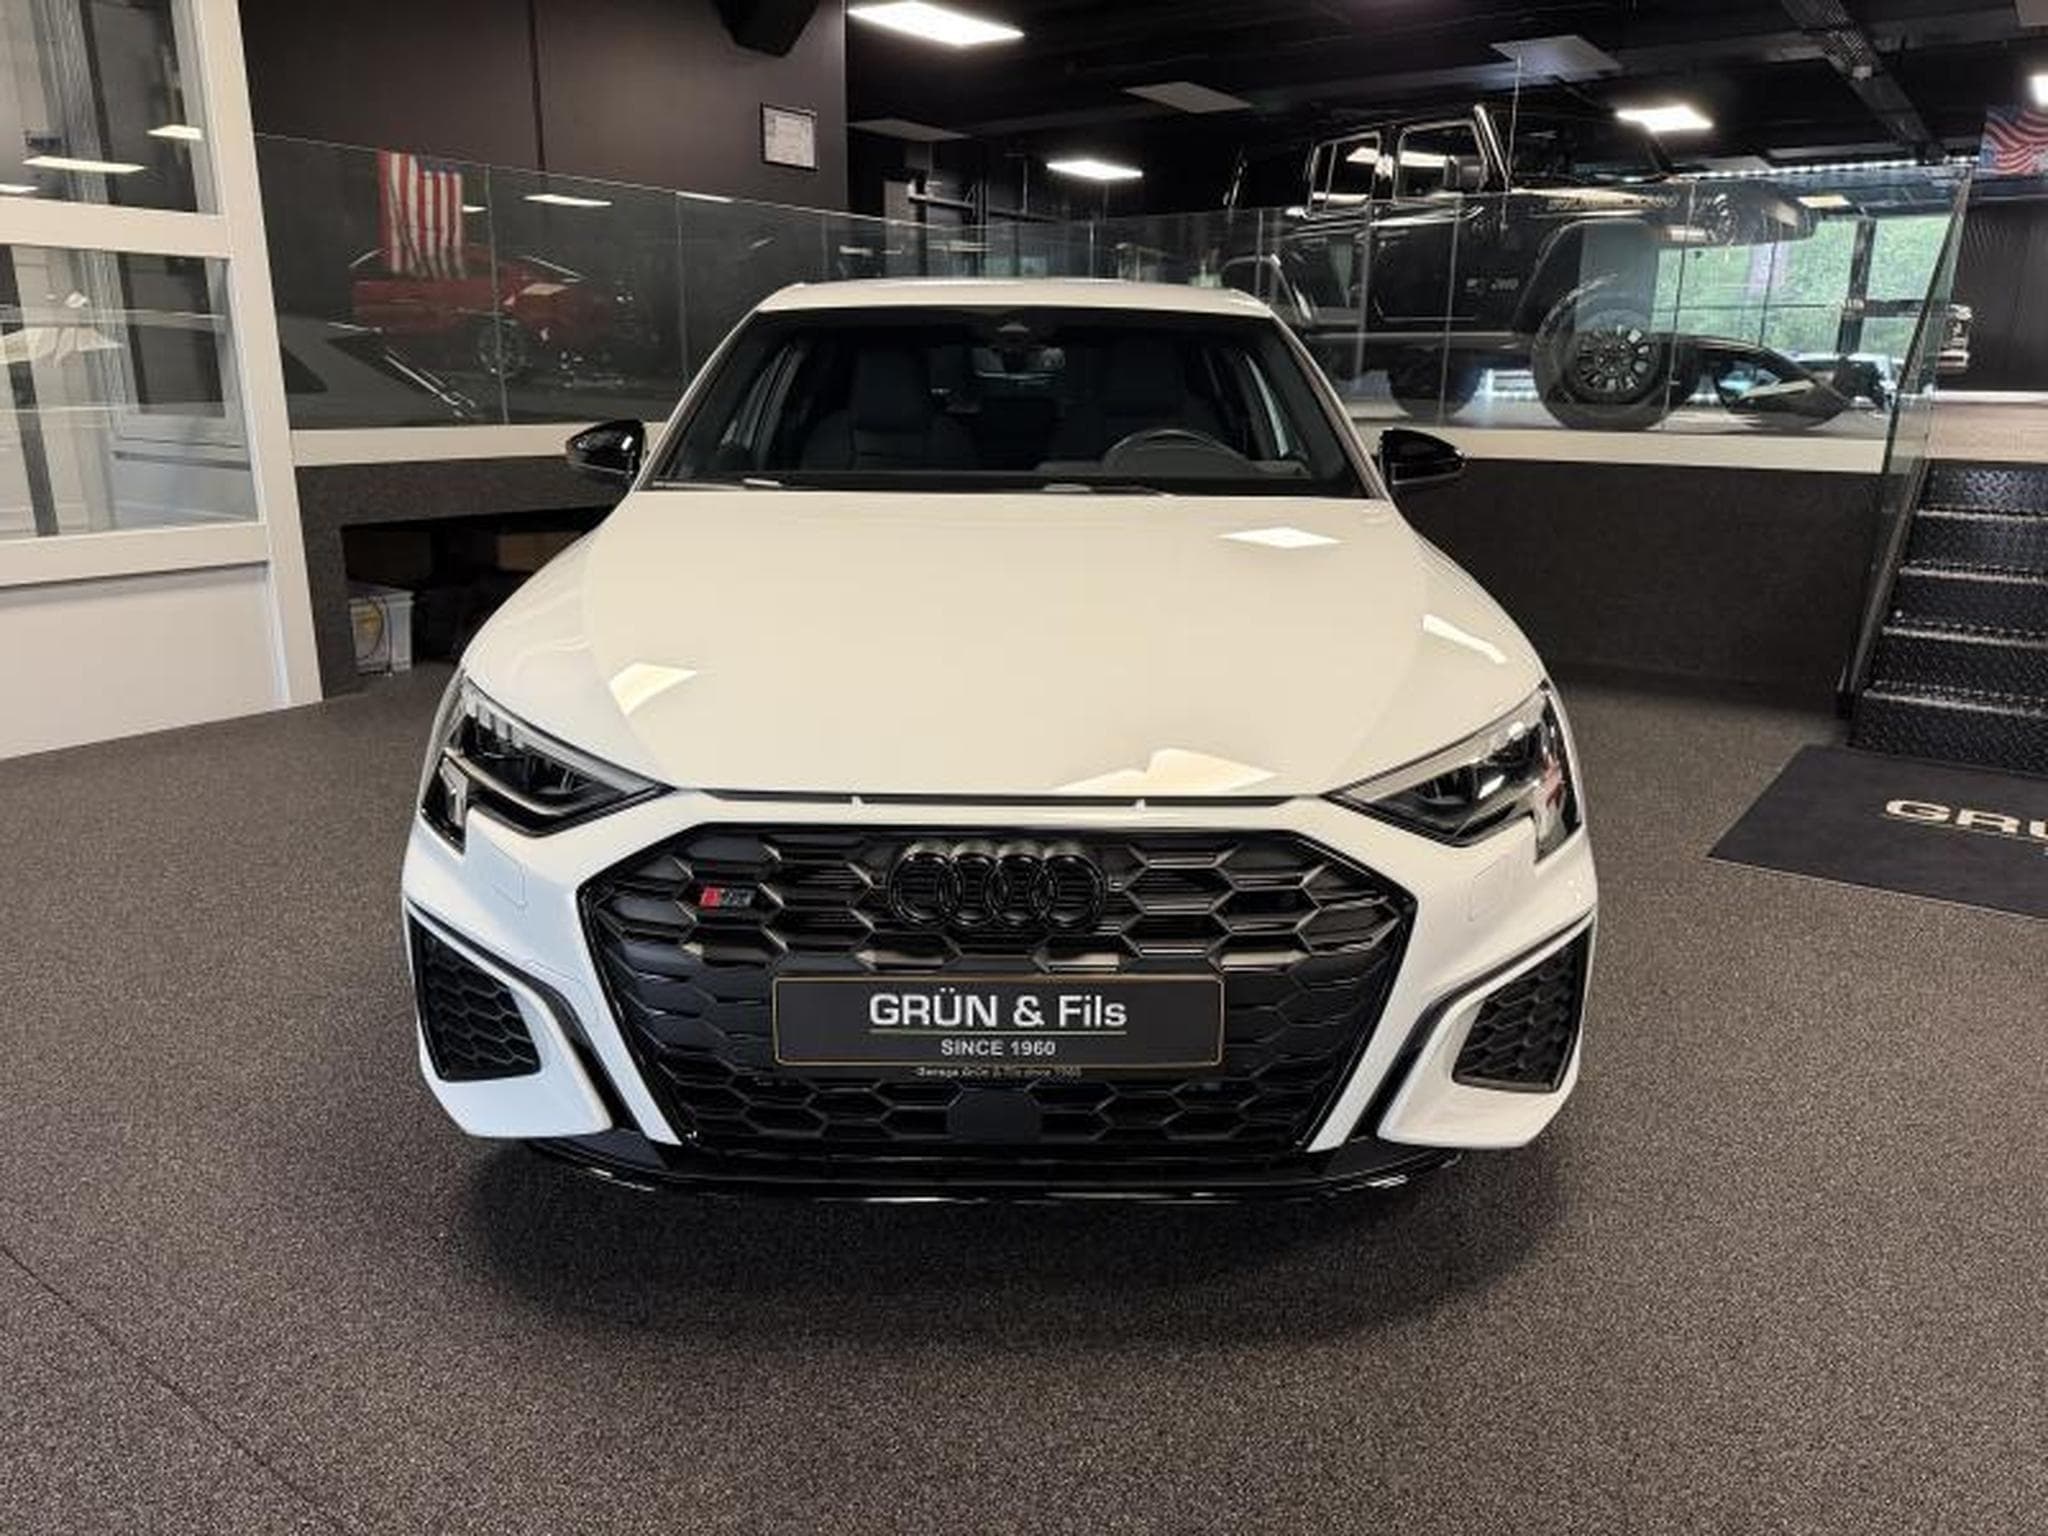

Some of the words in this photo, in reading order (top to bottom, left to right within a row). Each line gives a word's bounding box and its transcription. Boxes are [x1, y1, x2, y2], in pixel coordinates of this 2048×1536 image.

[869, 987, 998, 1028] GRÜN
[1012, 995, 1045, 1027] &
[1059, 994, 1127, 1028] Fils
[940, 1039, 1004, 1056] SINCE
[1010, 1039, 1056, 1056] 1960
